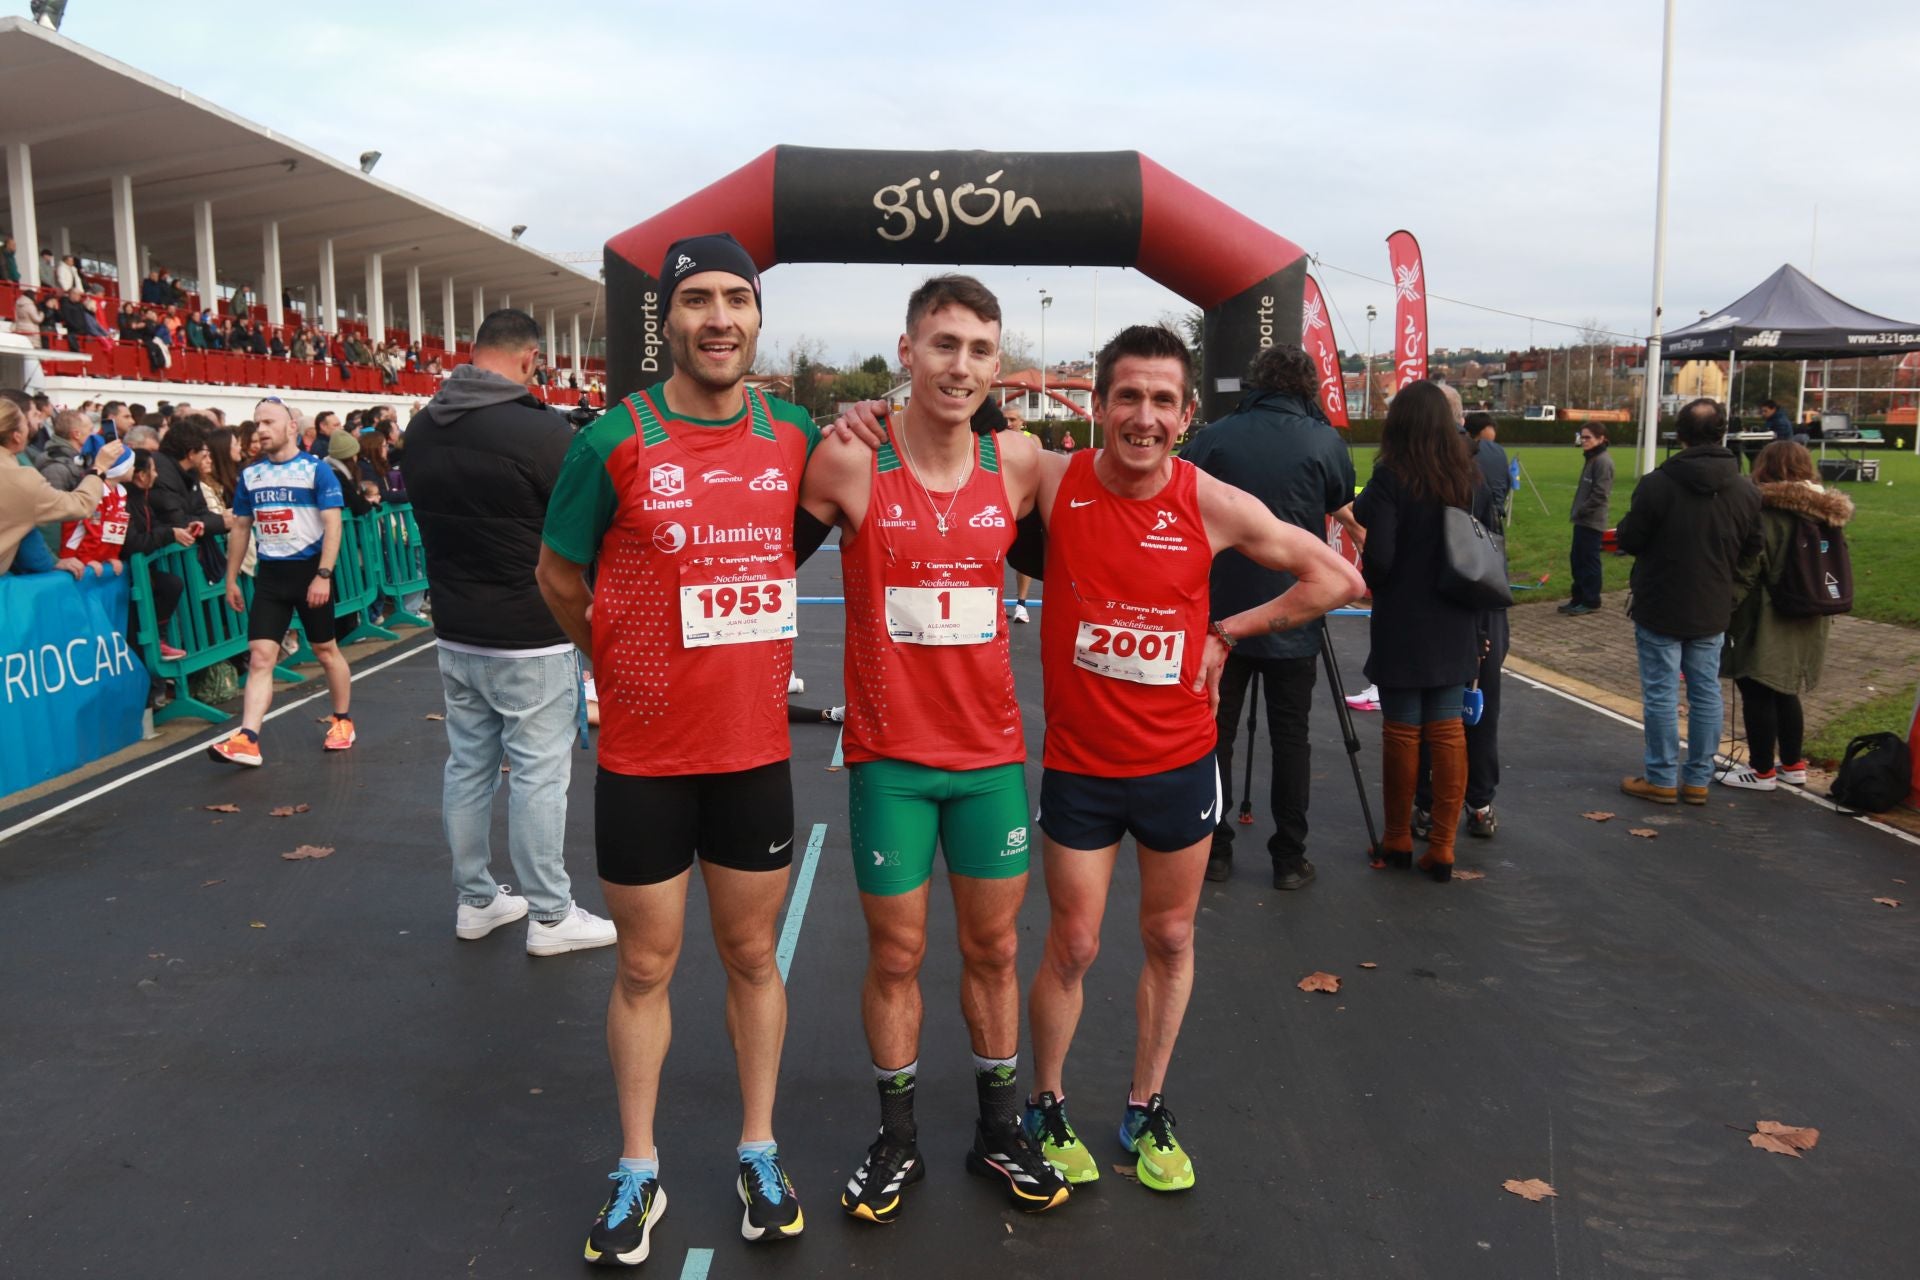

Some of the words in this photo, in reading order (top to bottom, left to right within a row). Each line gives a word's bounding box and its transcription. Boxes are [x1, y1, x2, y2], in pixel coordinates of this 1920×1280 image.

[873, 169, 1042, 243] gijón
[641, 291, 663, 372] Deporte
[1257, 295, 1275, 351] porte
[643, 498, 693, 511] Llanes
[260, 522, 290, 535] 1452
[692, 522, 782, 545] Llamieva
[942, 570, 952, 578] de
[955, 561, 983, 571] Popular
[713, 573, 768, 584] Nochebuena
[918, 578, 970, 587] Nochebuena
[697, 584, 782, 618] 1953
[937, 591, 950, 620] 1
[1111, 618, 1164, 631] Nochebuena
[1136, 613, 1147, 621] de
[1088, 628, 1177, 661] 2001
[0, 632, 134, 704] RIOCAR
